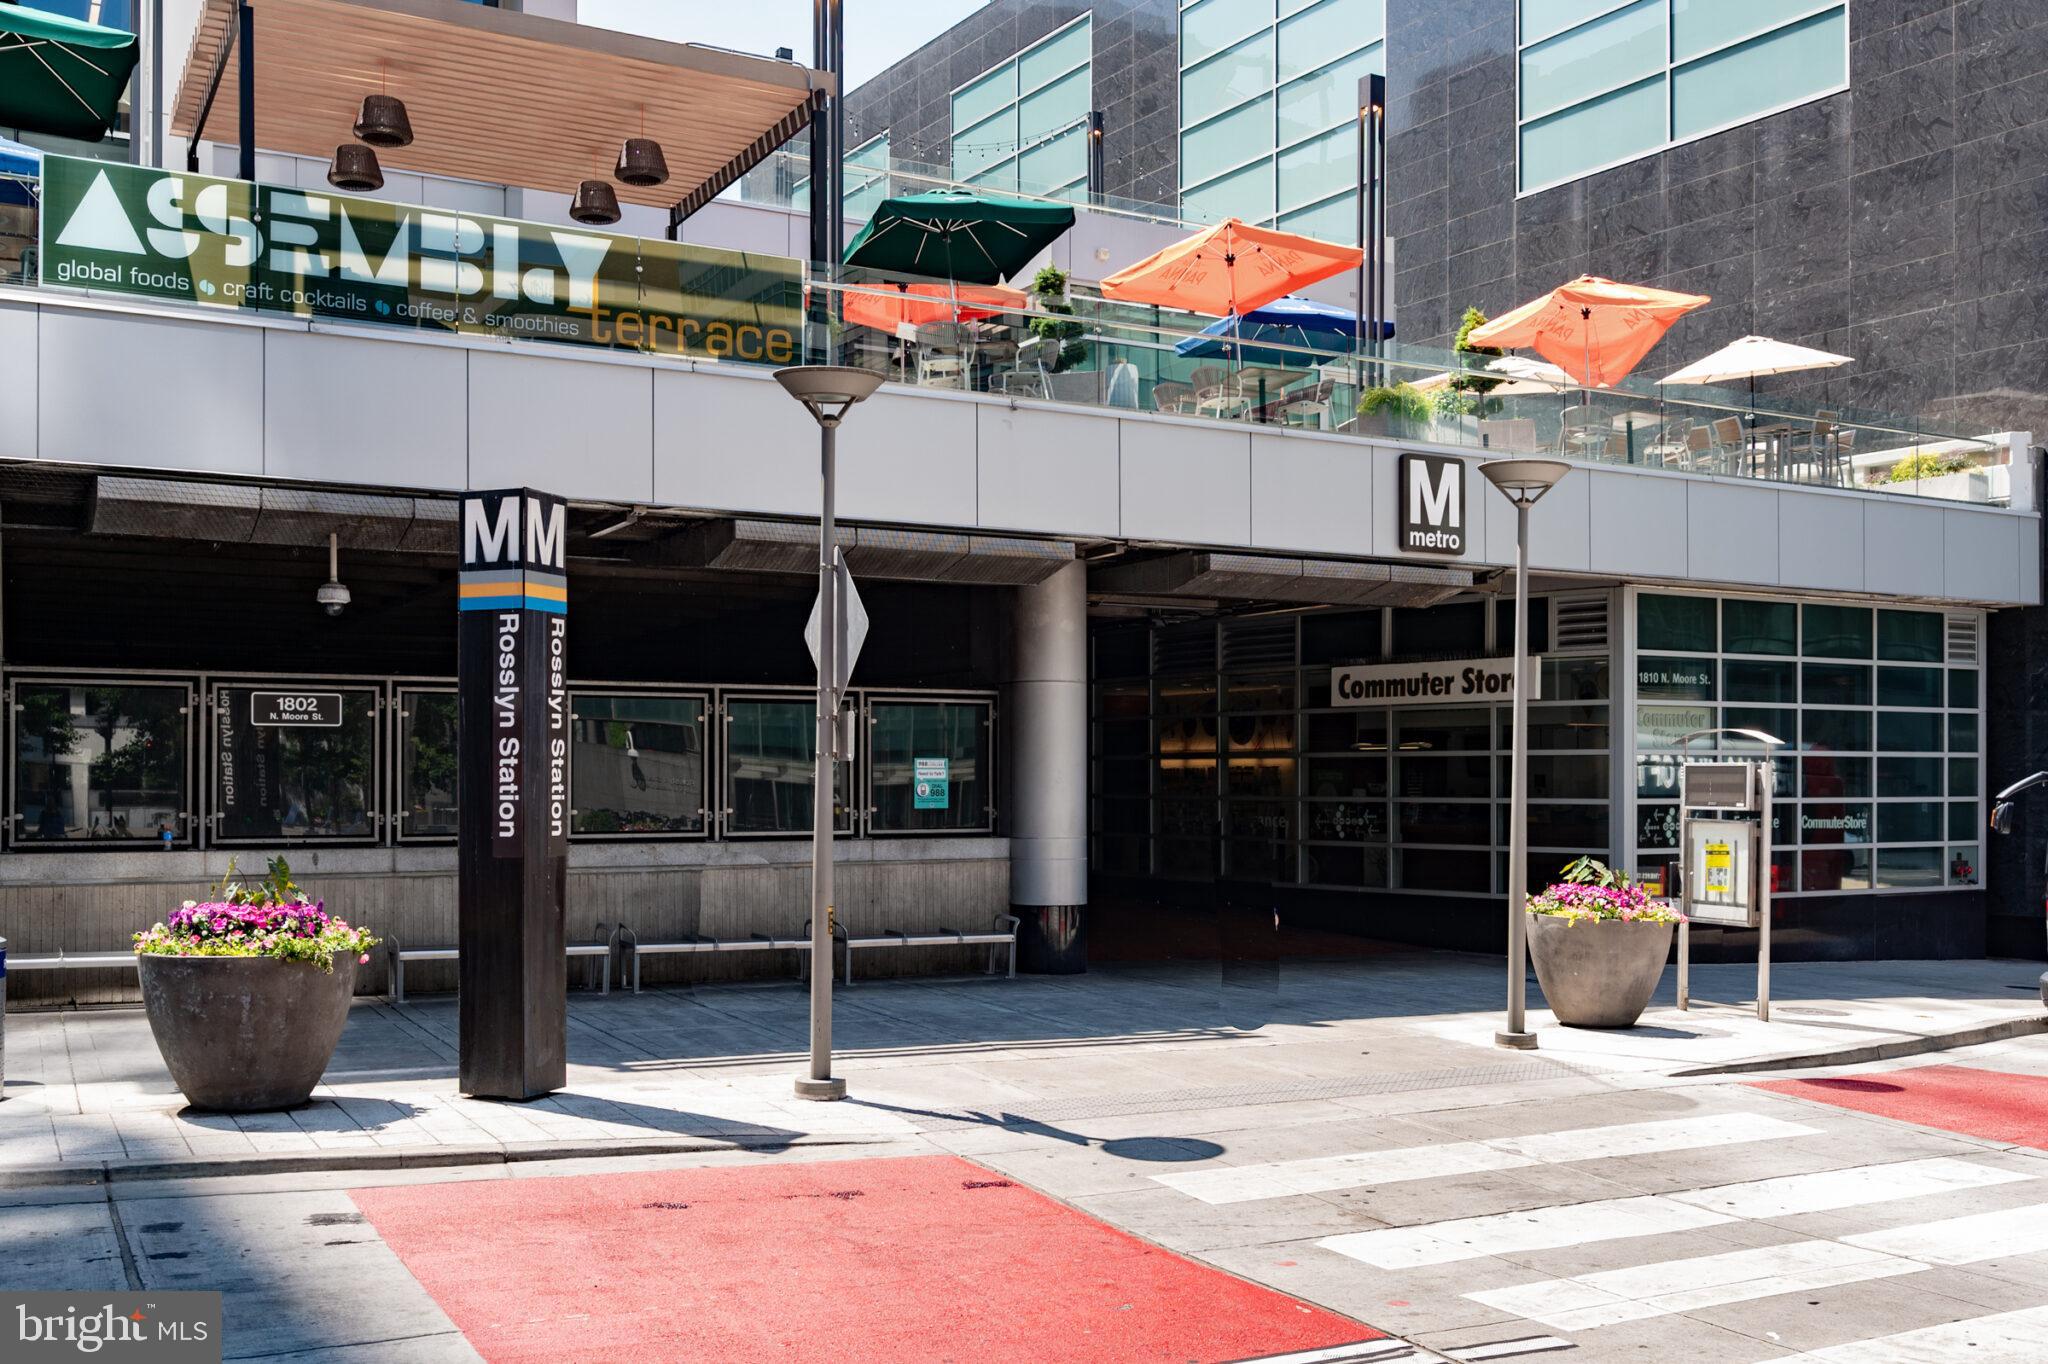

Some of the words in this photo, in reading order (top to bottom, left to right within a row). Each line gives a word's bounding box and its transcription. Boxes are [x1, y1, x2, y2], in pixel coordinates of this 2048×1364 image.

[55, 167, 613, 307] ASSEMBLY
[57, 259, 122, 282] global
[129, 267, 190, 291] foods
[223, 281, 274, 300] craft
[280, 289, 367, 312] cocktails
[396, 302, 455, 322] coffee
[462, 307, 479, 324] &
[484, 313, 580, 336] smoothies
[568, 275, 793, 363] terrace
[1409, 459, 1460, 528] M
[464, 495, 521, 565] M
[527, 497, 565, 569] M
[1409, 530, 1460, 550] metro
[276, 697, 318, 711] 1802
[494, 613, 520, 729] Rosslyn
[548, 617, 565, 730] Rosslyn
[1338, 672, 1455, 700] Commuter
[1638, 672, 1659, 684] 1810
[1661, 673, 1670, 684] N.
[1672, 673, 1697, 685] Moore
[1699, 674, 1711, 685] St.
[269, 712, 279, 720] N.
[281, 712, 309, 720] Moore
[312, 712, 324, 720] St.
[498, 736, 520, 838] Station
[551, 738, 565, 837] Station
[930, 788, 945, 797] 988
[1802, 815, 1867, 830] CommuterStore
